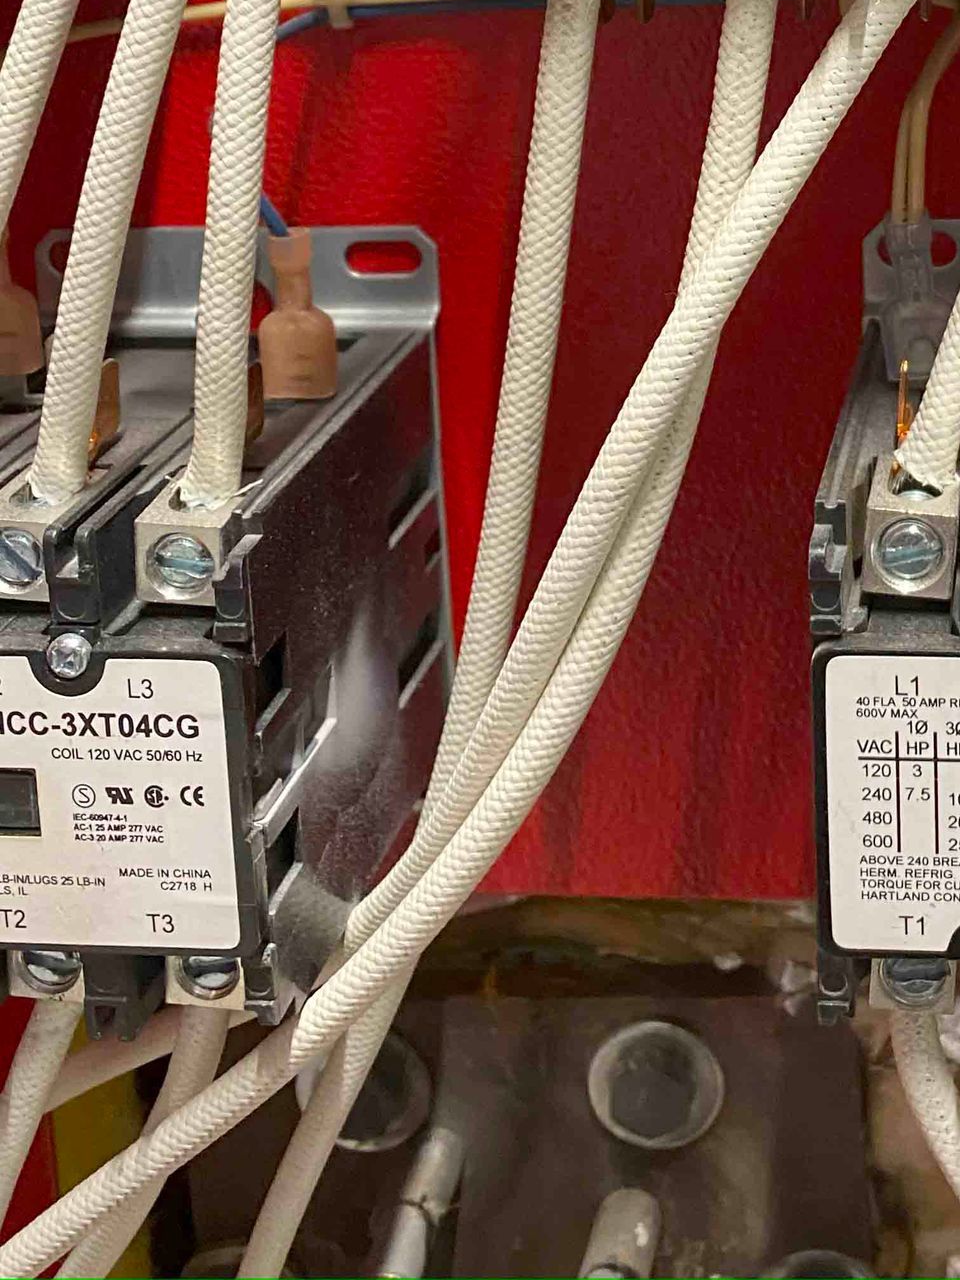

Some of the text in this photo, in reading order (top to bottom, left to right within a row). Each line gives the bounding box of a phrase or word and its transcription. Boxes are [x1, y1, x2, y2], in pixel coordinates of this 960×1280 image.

[127, 678, 154, 699] L3
[895, 675, 920, 697] L1
[856, 708, 919, 719] 600V MAX
[857, 739, 893, 754] VAC
[907, 742, 930, 755] HP
[51, 748, 203, 762] COIL 120 VAC 50/60 Hz
[862, 764, 922, 778] 120 3
[862, 787, 892, 801] 240
[906, 787, 931, 802] 7.5
[862, 811, 892, 826] 480
[862, 835, 893, 849] 600
[860, 855, 904, 866] ABOVE
[908, 856, 929, 867] 240
[119, 868, 212, 879] MADE IN CHINA
[161, 881, 212, 892] C2718 H
[861, 891, 930, 902] HARTLAND
[0, 909, 27, 929] T2
[146, 914, 175, 933] T3
[899, 916, 925, 936] T1
